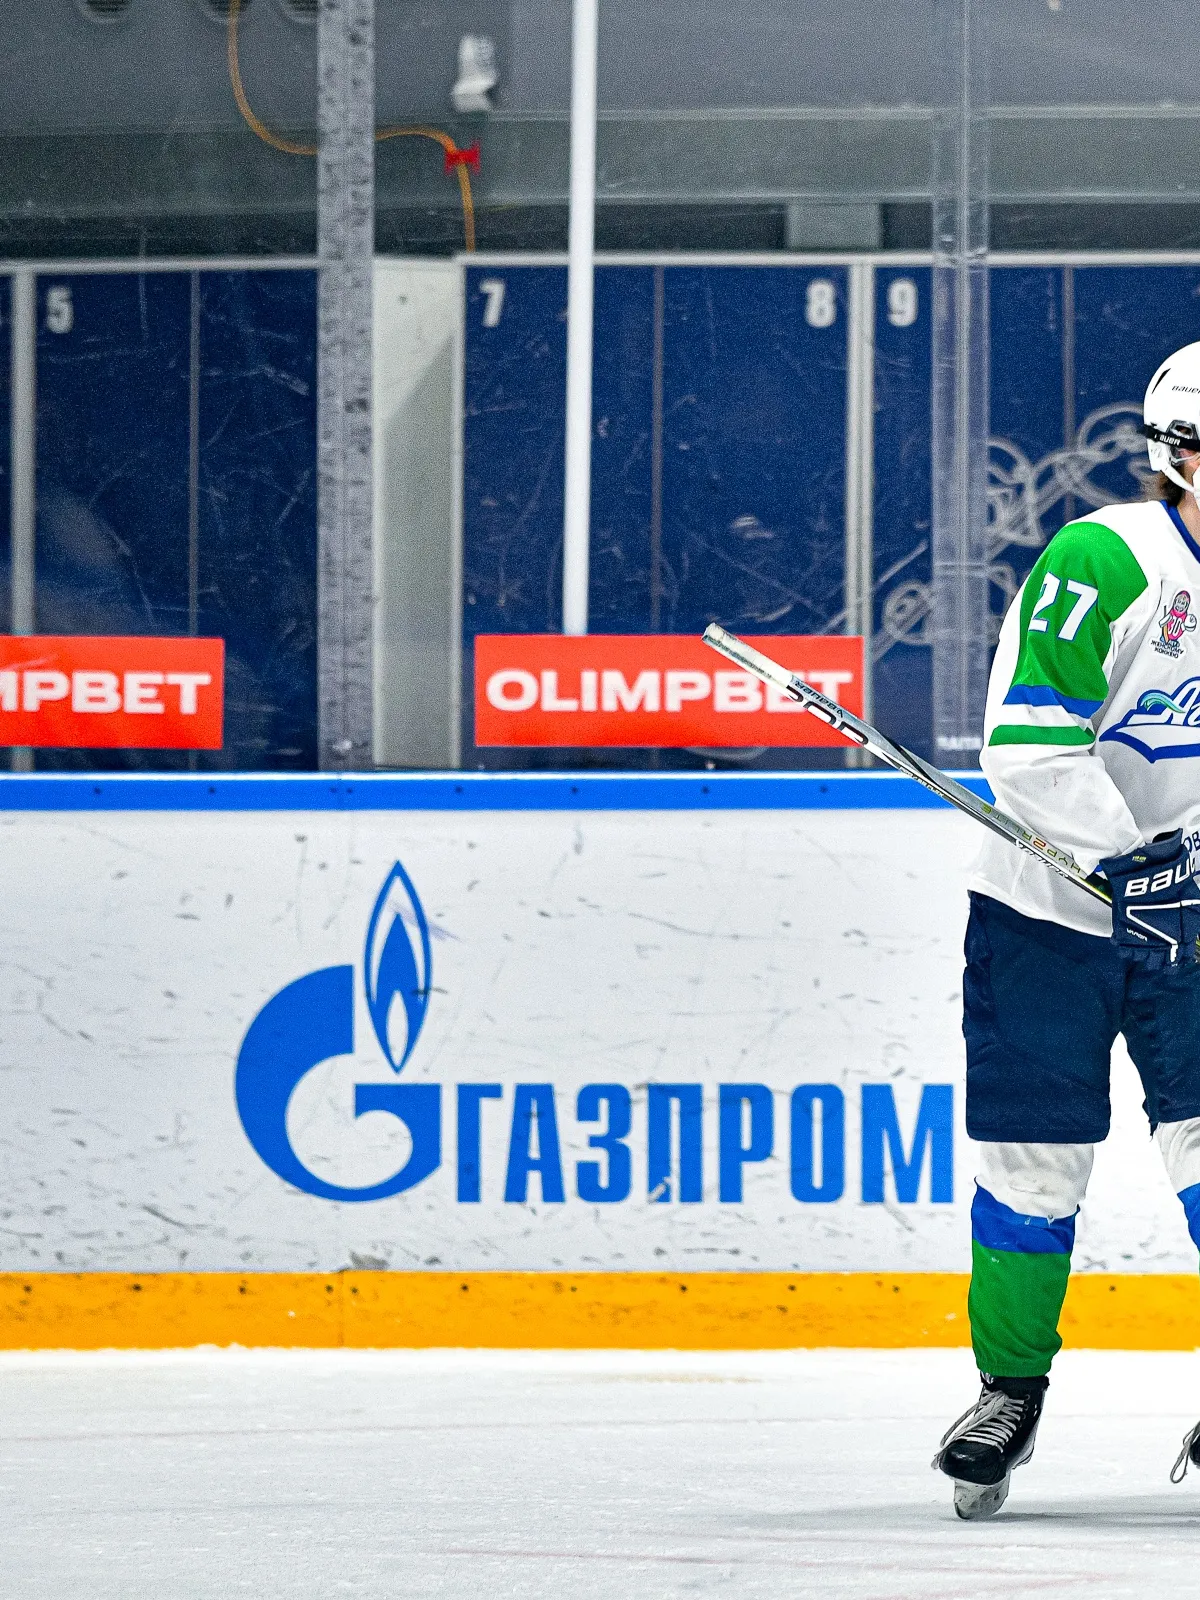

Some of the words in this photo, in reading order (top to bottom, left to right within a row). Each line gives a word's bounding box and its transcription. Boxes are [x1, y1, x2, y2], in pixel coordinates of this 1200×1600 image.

[46, 286, 74, 334] 5
[480, 279, 505, 327] 7
[806, 279, 836, 328] 8
[886, 279, 918, 328] 9
[1028, 570, 1100, 643] 27
[1124, 857, 1196, 898] BAU
[456, 1082, 955, 1204] ГАЗПРОМ
